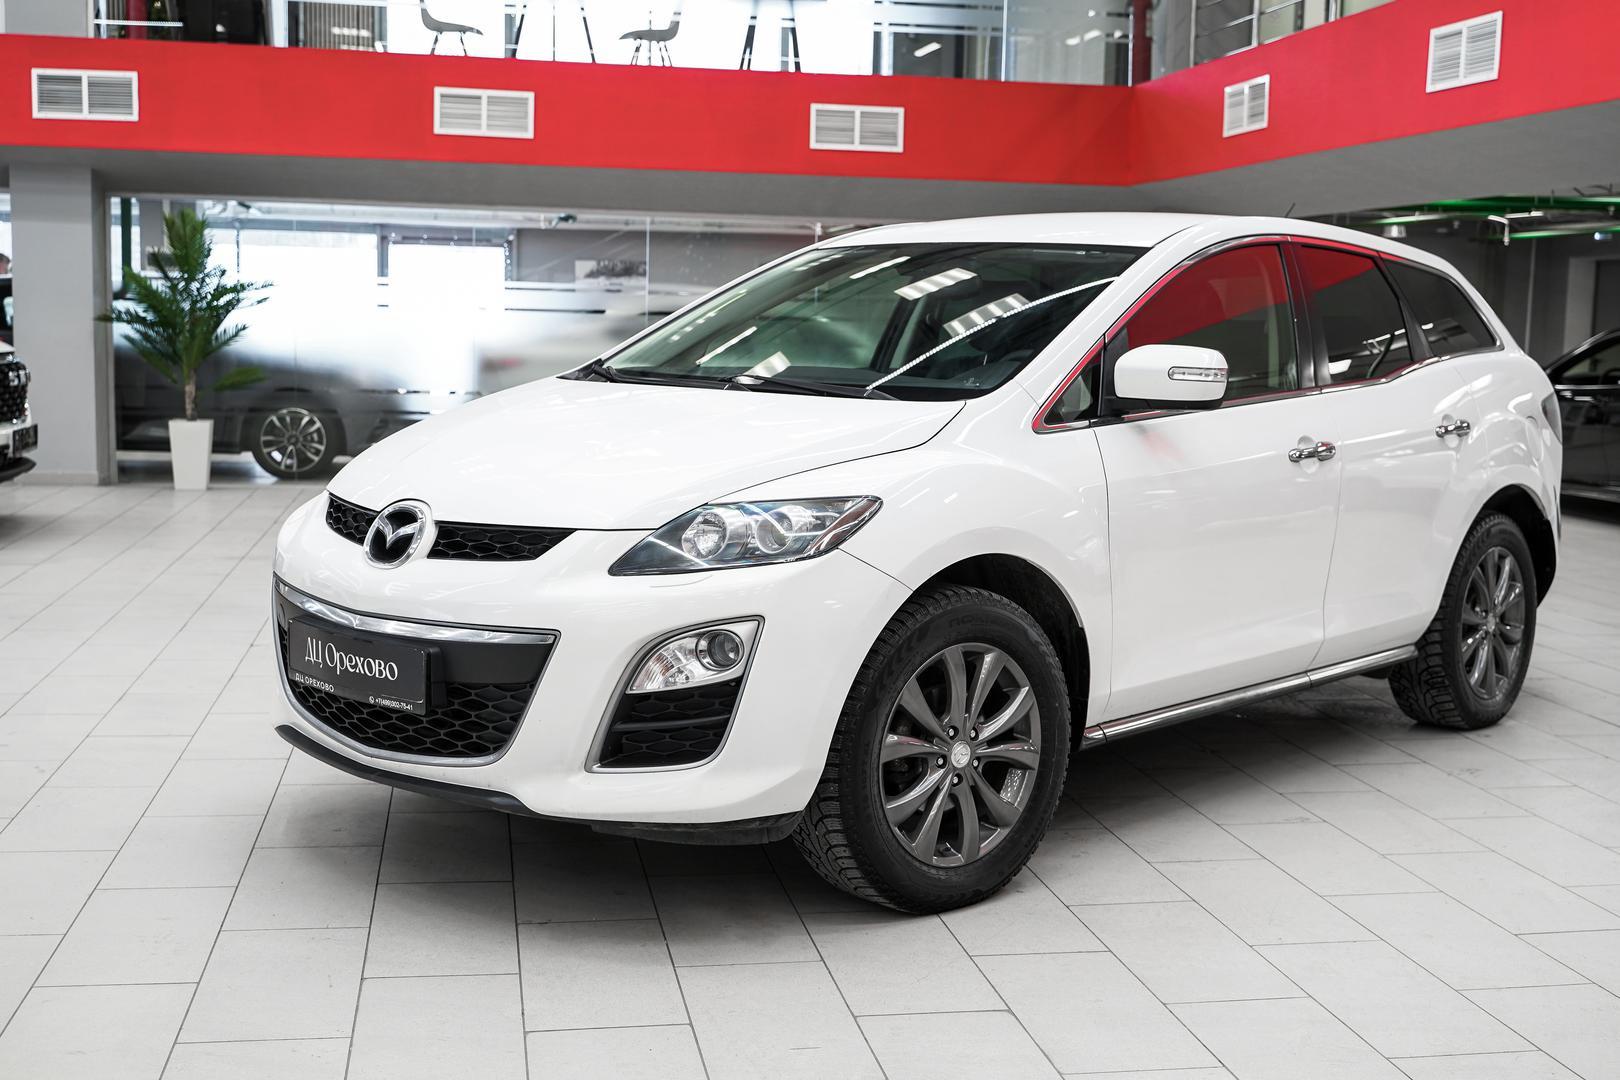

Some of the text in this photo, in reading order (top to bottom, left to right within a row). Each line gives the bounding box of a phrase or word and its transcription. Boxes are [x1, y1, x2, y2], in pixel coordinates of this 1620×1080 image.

[305, 637, 398, 681] ДЦ Орехово
[295, 673, 335, 692] ДЦ ОРЕХОВО
